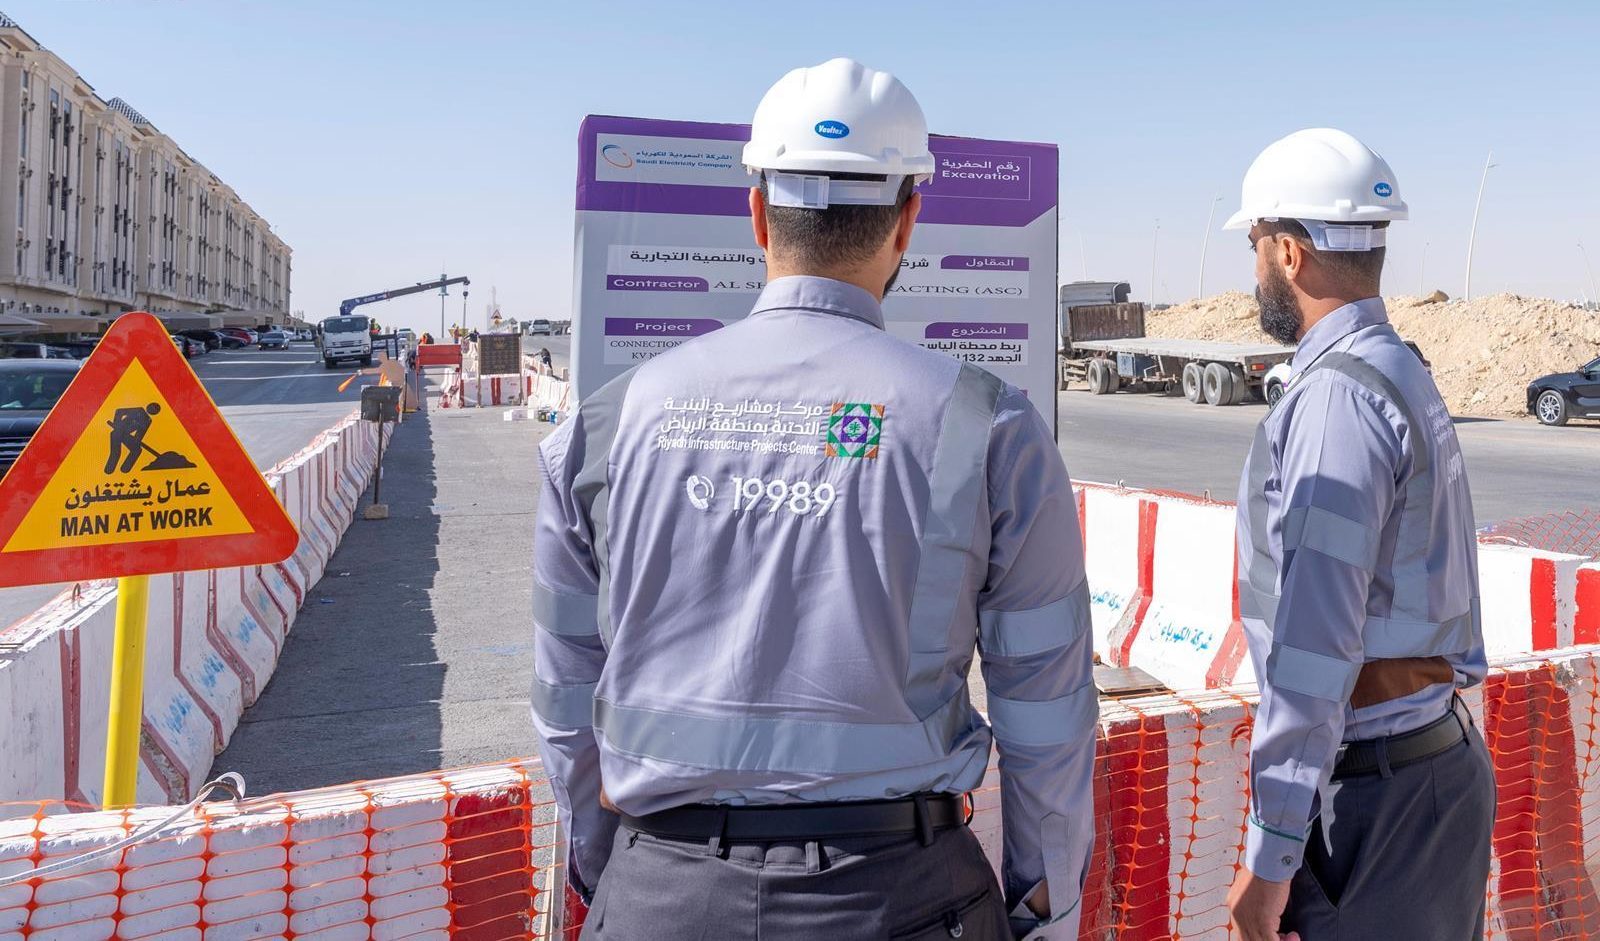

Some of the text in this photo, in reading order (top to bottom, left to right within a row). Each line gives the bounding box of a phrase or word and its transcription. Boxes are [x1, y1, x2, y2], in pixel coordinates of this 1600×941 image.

[942, 158, 1020, 172] رقم الحفرية
[942, 170, 1020, 181] Excavation
[630, 251, 689, 263] التجارية
[692, 253, 755, 265] والتنمية
[900, 257, 929, 269] شرك
[965, 258, 1014, 267] المقاول
[613, 279, 700, 289] Contractor
[714, 281, 741, 289] AL
[975, 286, 1023, 295] (ASC)
[635, 322, 693, 332] Project
[951, 326, 1007, 337] المشروع
[959, 341, 997, 350] محطة
[999, 341, 1022, 352] ربط
[962, 353, 985, 362] 132
[987, 353, 1022, 364] الجهد
[660, 415, 820, 436] التحتية بمنطقة الرياض
[657, 435, 818, 456] Riyadh Infrastructure Projects Center
[65, 478, 211, 510] عمال يشتغلون
[731, 476, 836, 517] 19989
[61, 507, 213, 537] MAN AT WORK
